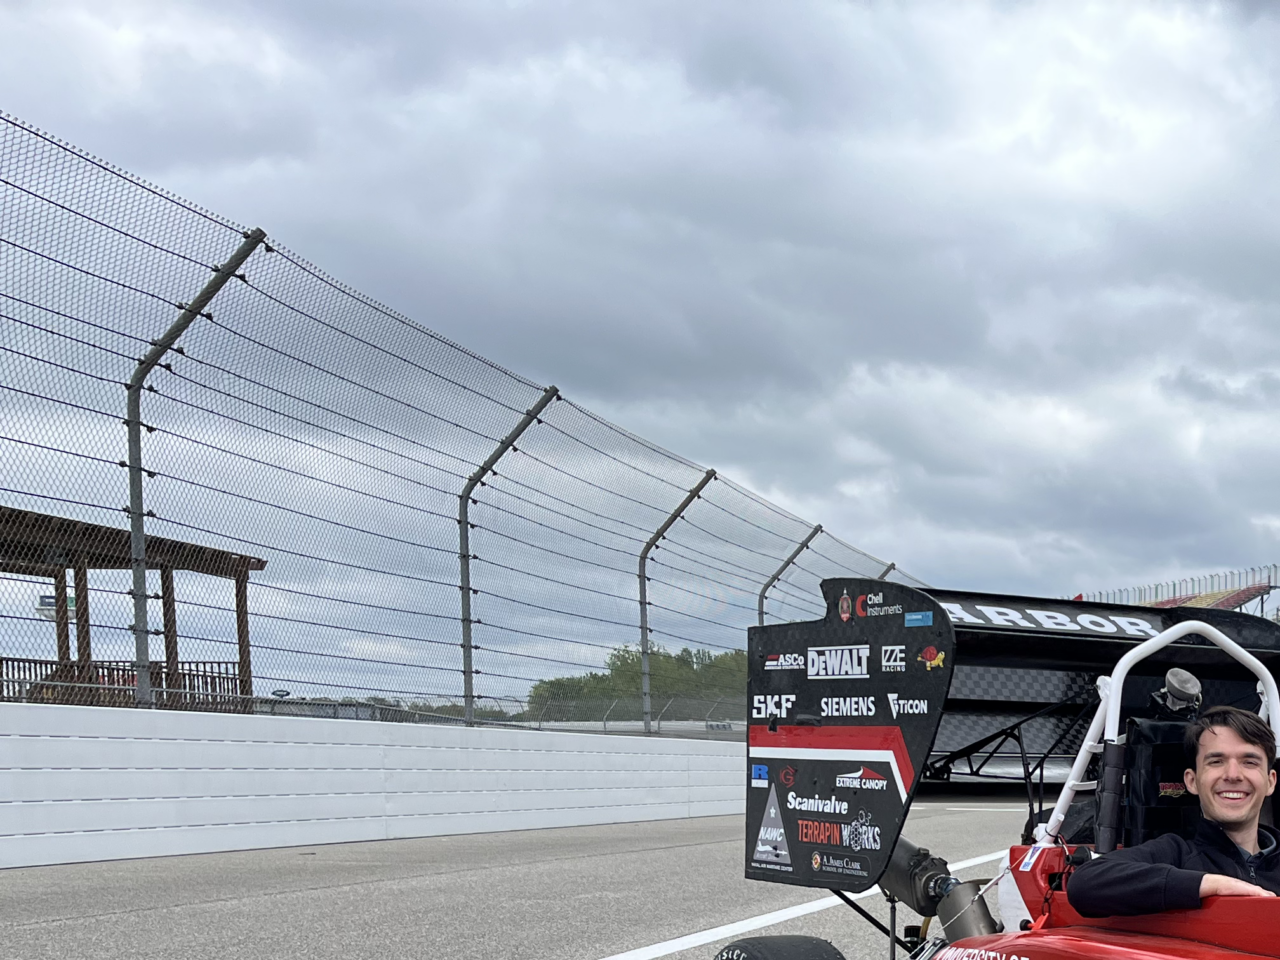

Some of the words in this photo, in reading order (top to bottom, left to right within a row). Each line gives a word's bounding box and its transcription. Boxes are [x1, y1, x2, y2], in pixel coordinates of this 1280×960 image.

[867, 592, 883, 604] Chell
[867, 604, 902, 616] Instruments
[808, 649, 870, 676] DEWALT
[752, 694, 796, 718] SKF
[820, 696, 876, 716] SIEMENS
[836, 777, 861, 788] EXTREME
[862, 779, 887, 790] CANOPY
[787, 791, 848, 814] Scanivalve
[759, 826, 784, 842] NAWC
[798, 819, 840, 845] TERRAPIN
[844, 858, 861, 869] CLARK
[843, 868, 868, 876] ENGINEERING
